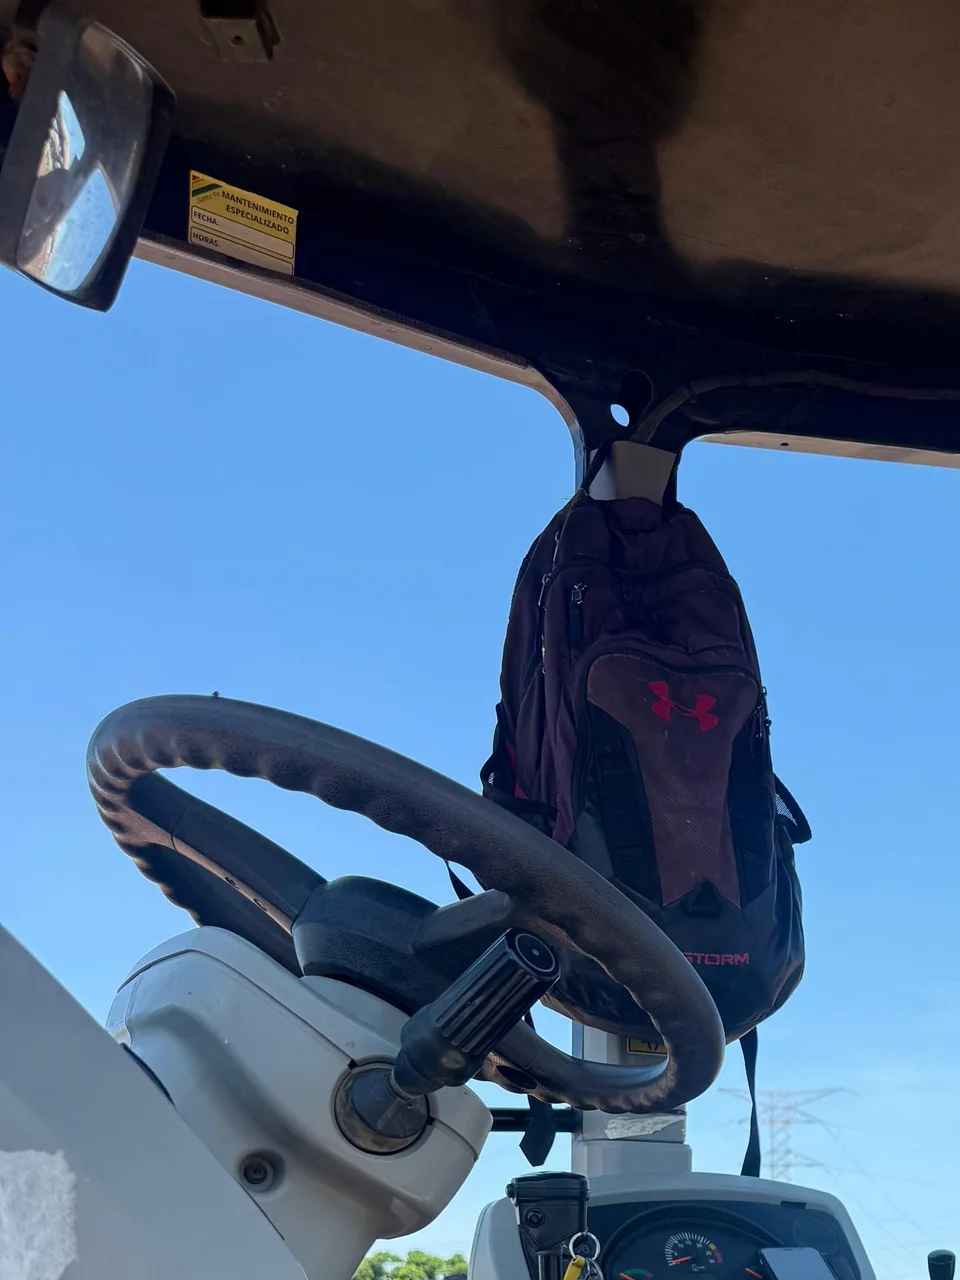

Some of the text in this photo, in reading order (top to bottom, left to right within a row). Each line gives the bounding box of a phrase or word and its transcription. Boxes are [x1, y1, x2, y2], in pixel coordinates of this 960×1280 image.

[193, 211, 220, 226] FECHA:
[222, 190, 294, 225] MANTENIMIENTO
[226, 204, 290, 235] ESPECIALIZADO
[683, 952, 749, 966] STORM
